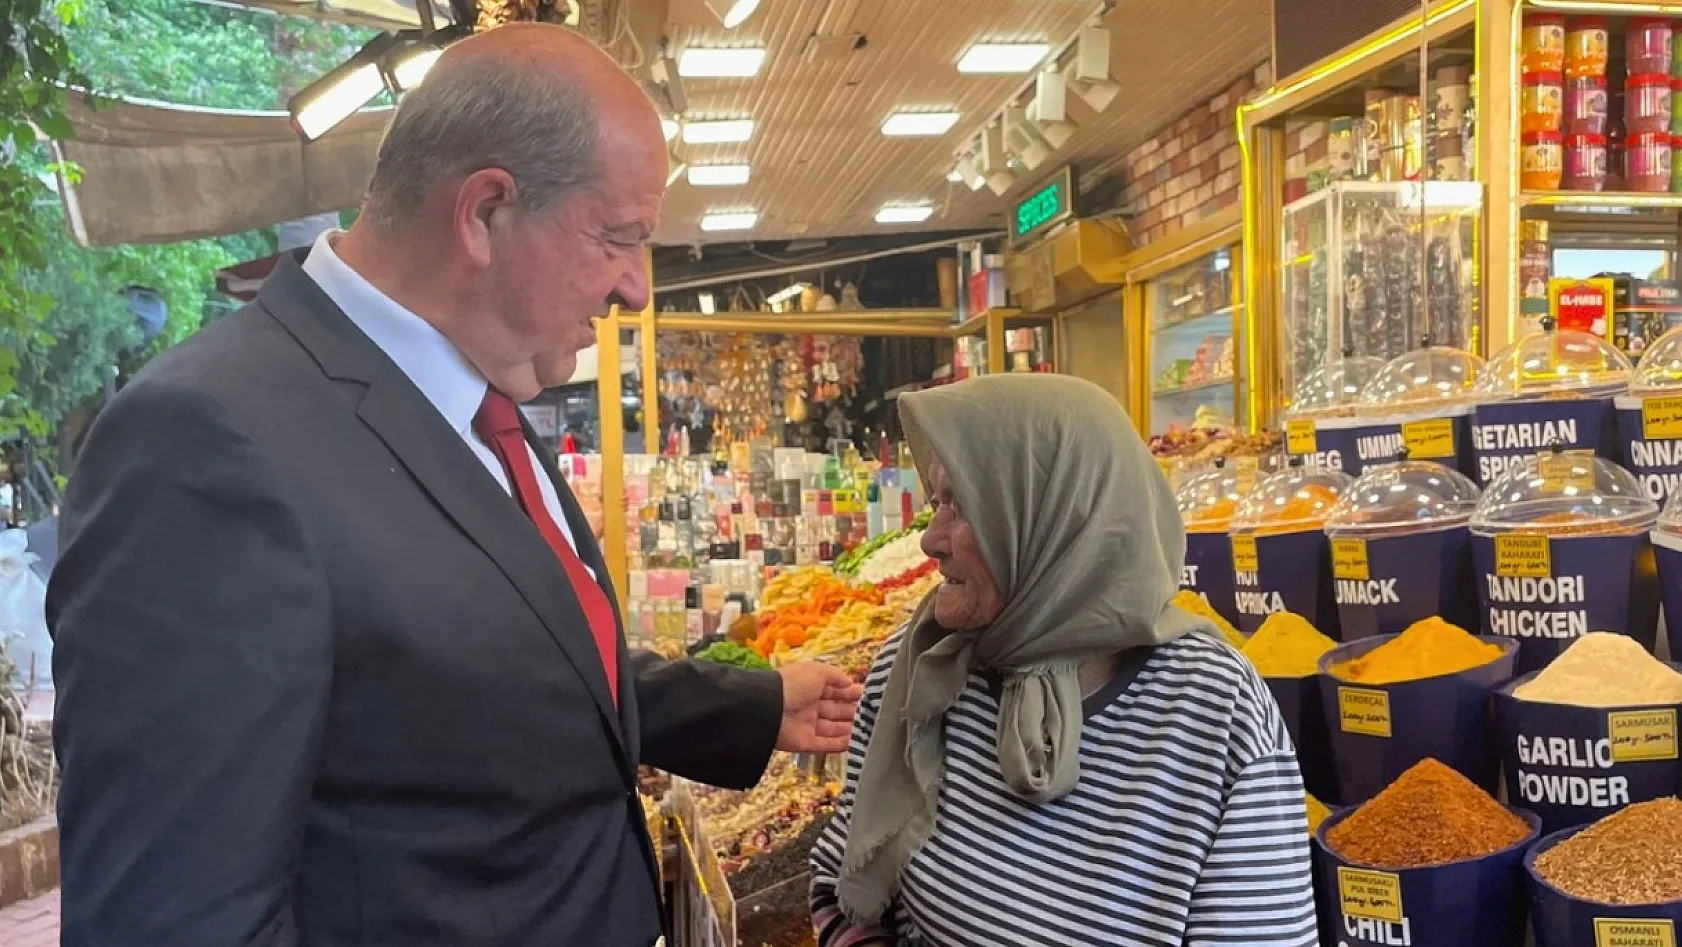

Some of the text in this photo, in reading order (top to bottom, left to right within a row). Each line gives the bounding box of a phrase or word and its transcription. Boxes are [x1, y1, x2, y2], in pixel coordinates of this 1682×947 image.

[1018, 184, 1059, 235] SPICES
[1486, 573, 1585, 604] TANDORI
[1490, 606, 1588, 639] CHICKEN
[1517, 733, 1614, 769] GARLIC
[1518, 769, 1630, 807] POWDER
[1344, 914, 1410, 946] CHILI
